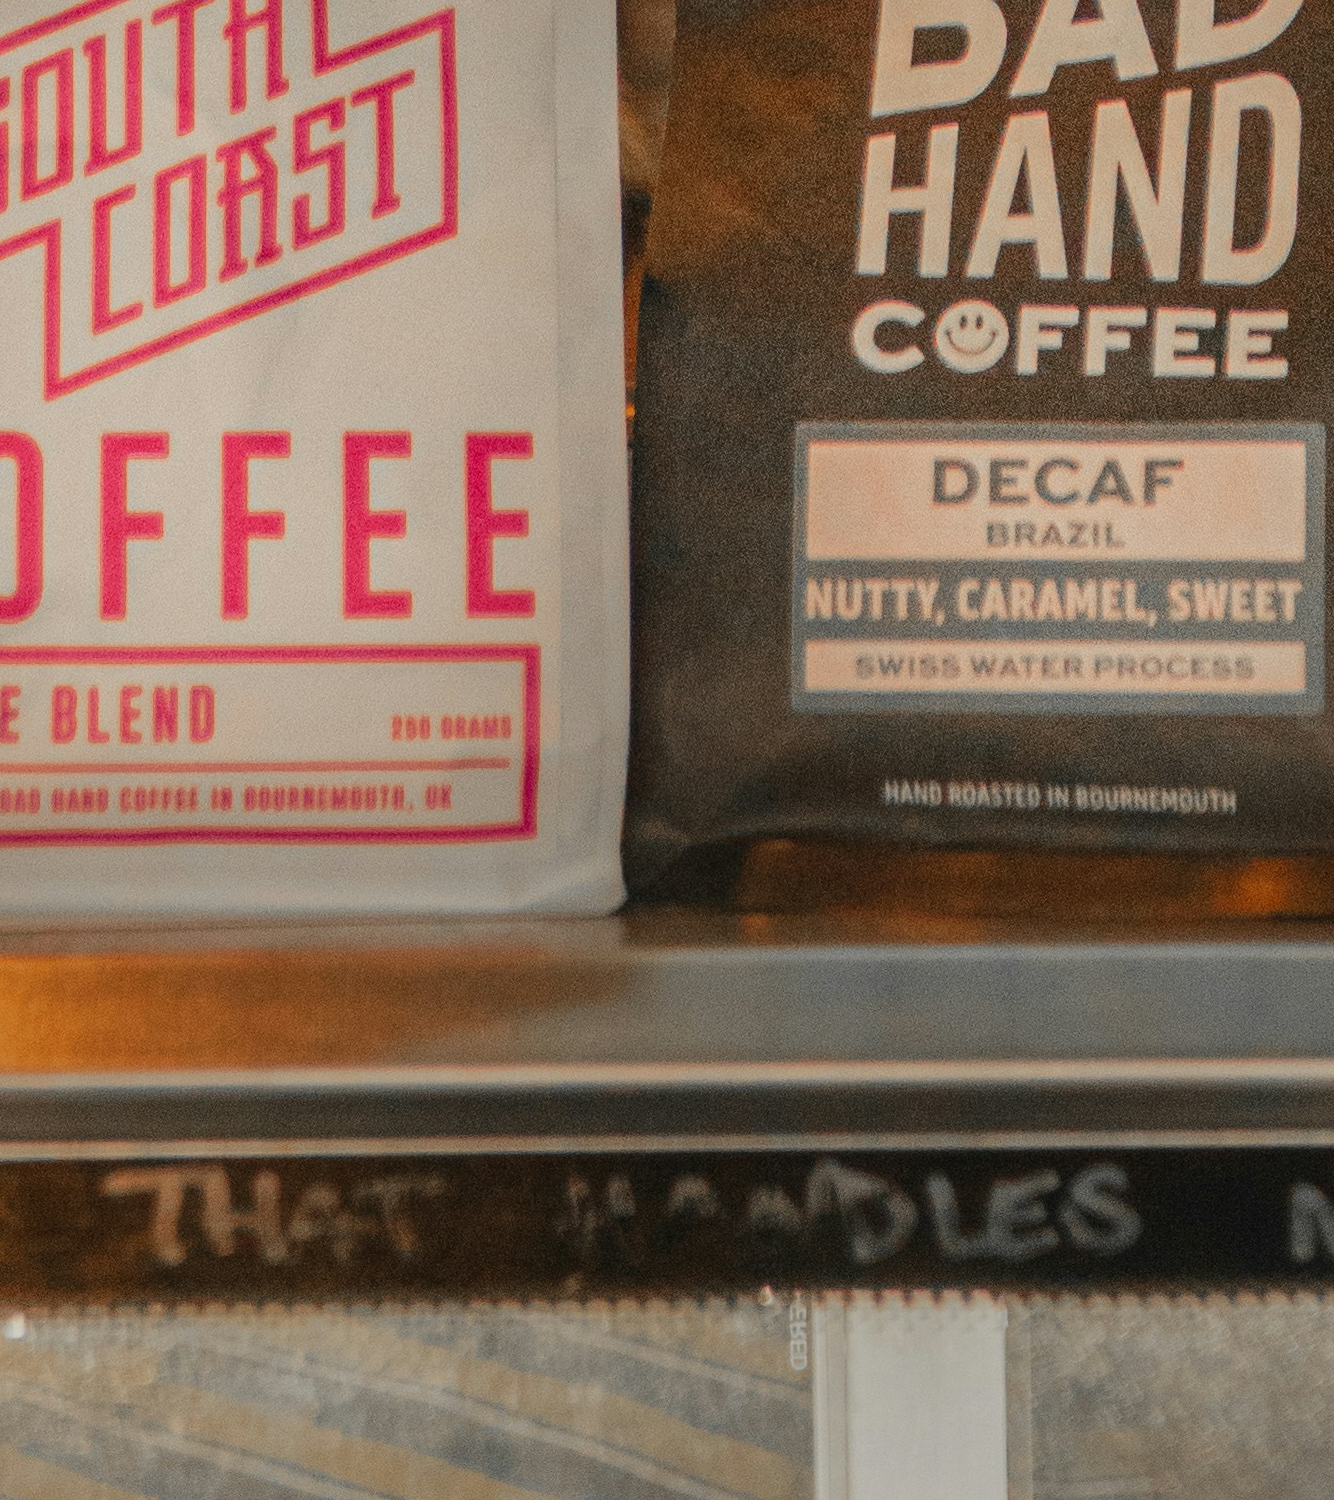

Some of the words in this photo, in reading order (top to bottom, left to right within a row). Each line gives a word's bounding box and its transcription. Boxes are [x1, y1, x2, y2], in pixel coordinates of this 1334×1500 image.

[91, 69, 417, 336] COAST
[855, 71, 1303, 286] HAND
[932, 457, 1185, 507] DECAF
[985, 520, 1125, 549] BRAZIL
[805, 577, 946, 627] NUTTY,
[955, 577, 1157, 628] CARAMEL,
[1168, 577, 1304, 624] SWEET
[854, 653, 962, 681] SWISS
[971, 654, 1085, 681] WATER
[1094, 655, 1257, 682] PROCESS
[50, 684, 216, 745] BLEND
[439, 713, 514, 741] GRAMS
[50, 786, 110, 815] HAND
[119, 786, 199, 814] COFFEE
[210, 785, 234, 813] IN
[883, 779, 943, 808] HAND
[948, 779, 1042, 810] ROASTED
[1048, 782, 1070, 810] IN
[1075, 783, 1238, 815] BOURNEMOUTH
[103, 1162, 449, 1268] THAT
